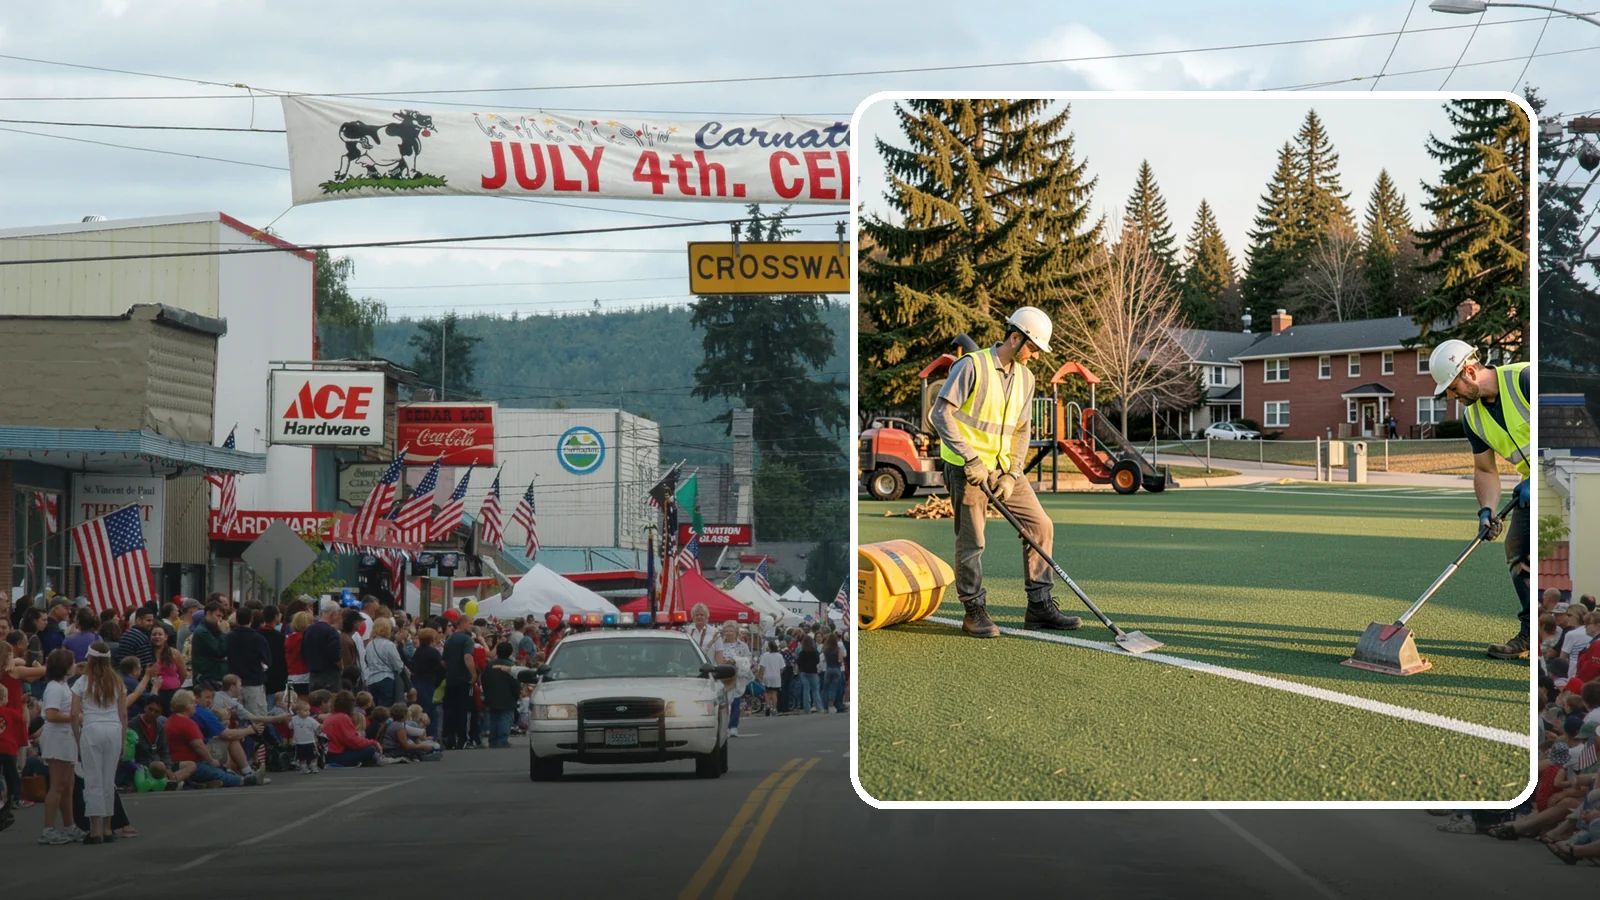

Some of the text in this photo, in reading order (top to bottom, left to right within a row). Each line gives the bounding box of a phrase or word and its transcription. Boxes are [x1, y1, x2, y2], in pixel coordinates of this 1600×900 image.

[481, 140, 605, 193] JULY
[632, 150, 747, 198] 4th.
[696, 254, 850, 280] CROSSWA
[282, 380, 374, 420] ACE
[405, 409, 485, 421] CEDAR LOG
[283, 421, 371, 436] Hardware
[95, 485, 125, 495] Vincent
[126, 486, 136, 495] de
[137, 486, 155, 495] Paul
[212, 516, 331, 535] HARDARE
[688, 526, 741, 535] CRNATION
[699, 535, 730, 543] GLASS
